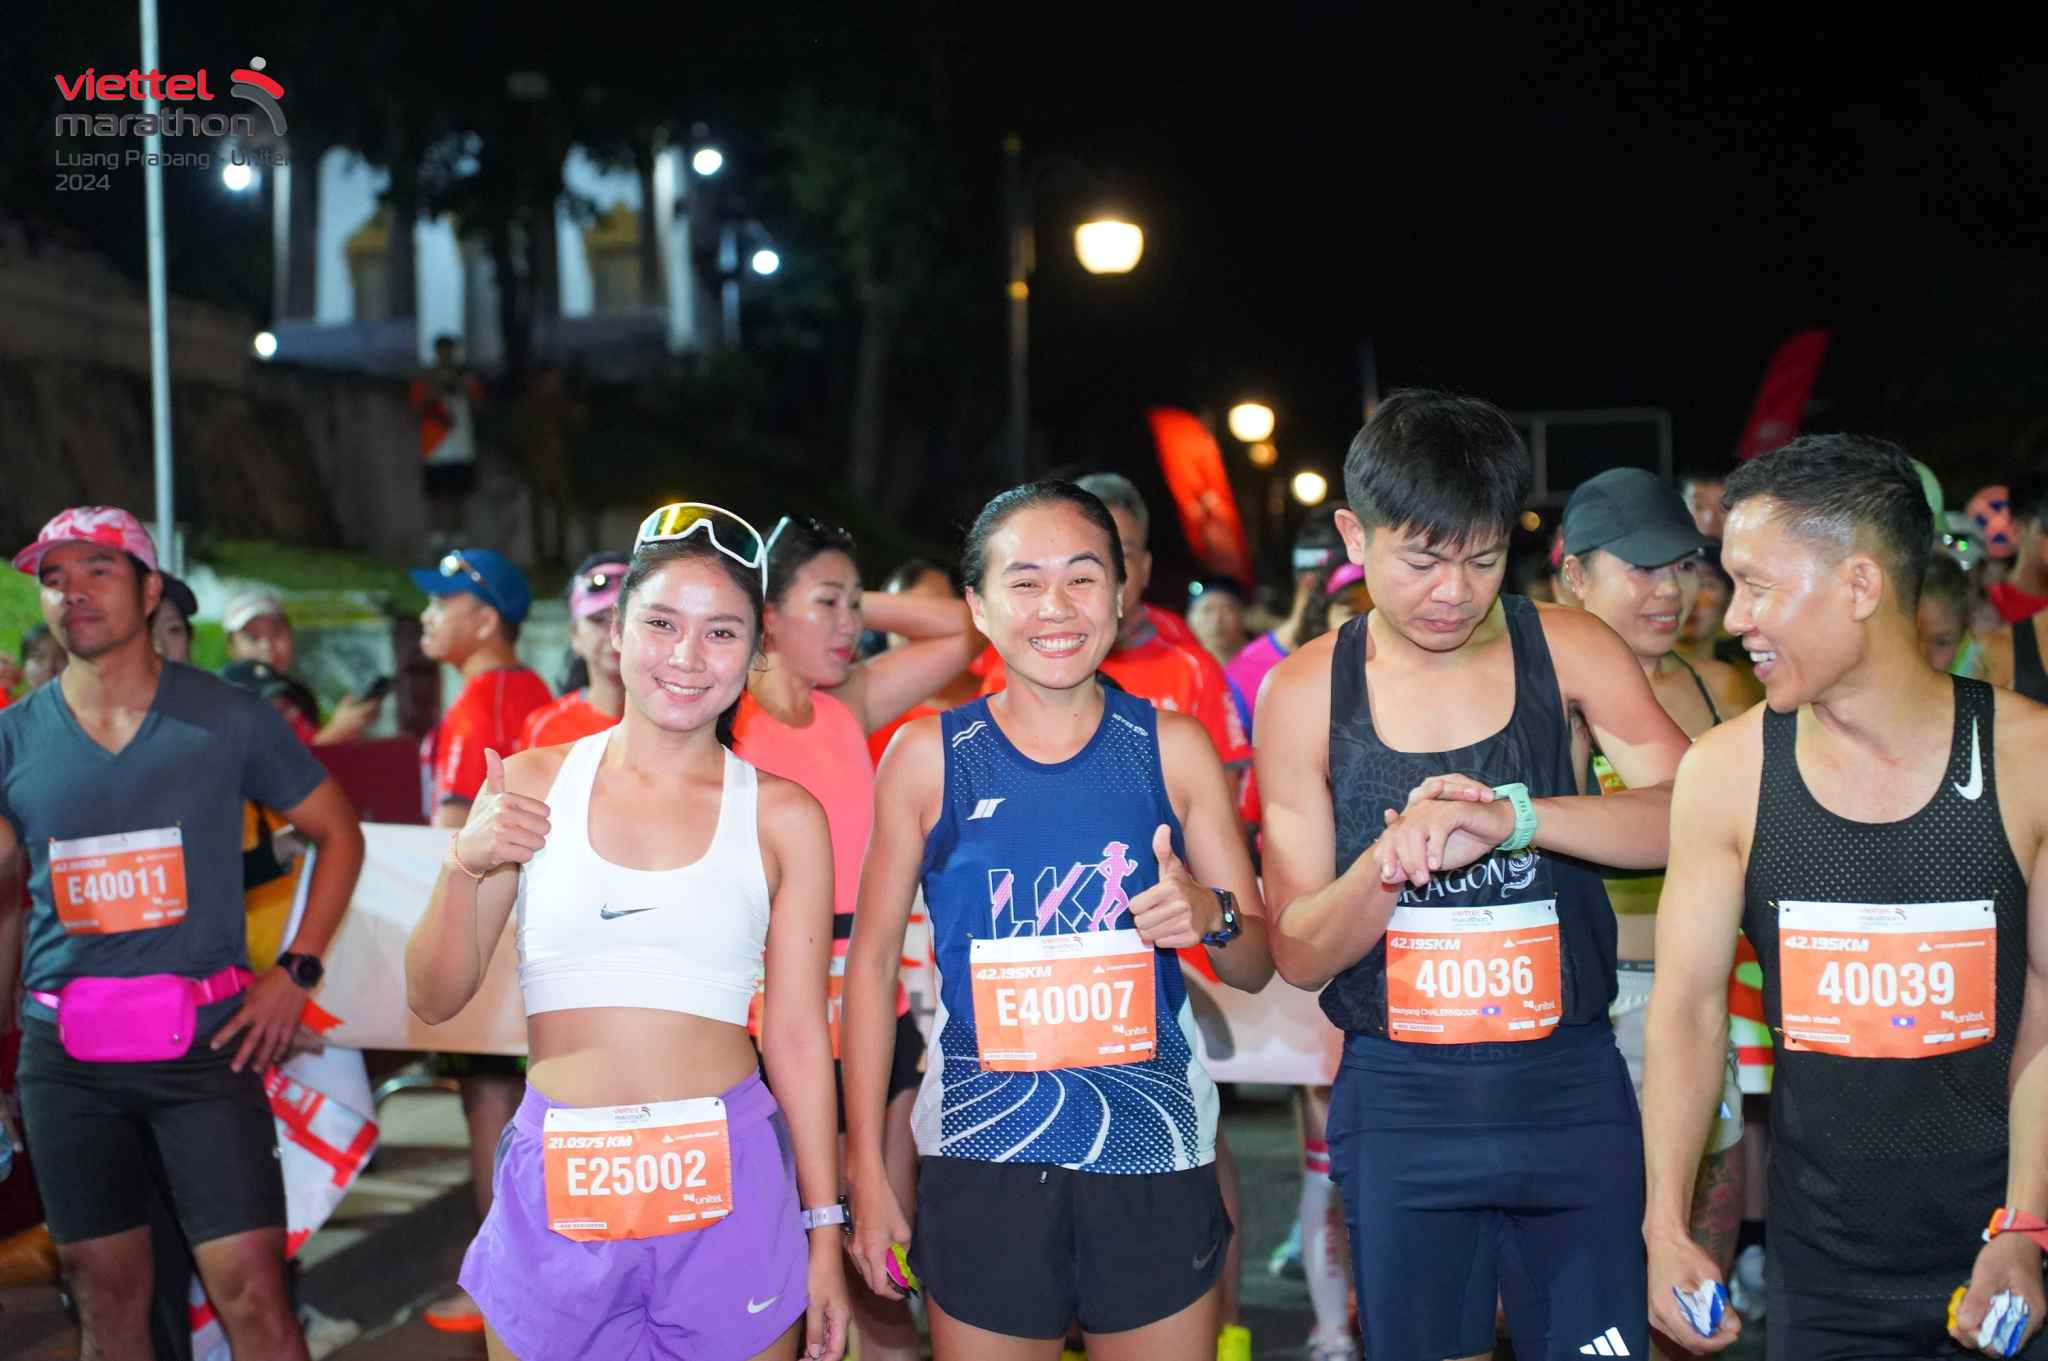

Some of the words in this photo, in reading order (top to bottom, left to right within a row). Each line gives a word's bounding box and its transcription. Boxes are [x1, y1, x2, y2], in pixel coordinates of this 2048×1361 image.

[67, 864, 167, 906] E40011
[1398, 857, 1505, 904] RAGON
[1451, 909, 1480, 917] viettel
[1042, 936, 1070, 944] viettel
[1390, 937, 1461, 950] 42.195KM
[1784, 935, 1870, 952] 42.195KM
[976, 965, 1053, 980] 42.195KM
[1415, 955, 1534, 999] 40036
[1816, 960, 1956, 1007] 40039
[996, 980, 1135, 1027] E40007
[1534, 1001, 1556, 1011] unitel
[1954, 1011, 1986, 1023] unitel
[1124, 1025, 1149, 1036] unitel
[613, 1107, 639, 1115] viettel
[548, 1136, 604, 1149] 21.0975
[606, 1135, 633, 1148] KM
[567, 1149, 707, 1197] E25002
[695, 1193, 723, 1205] unitel
